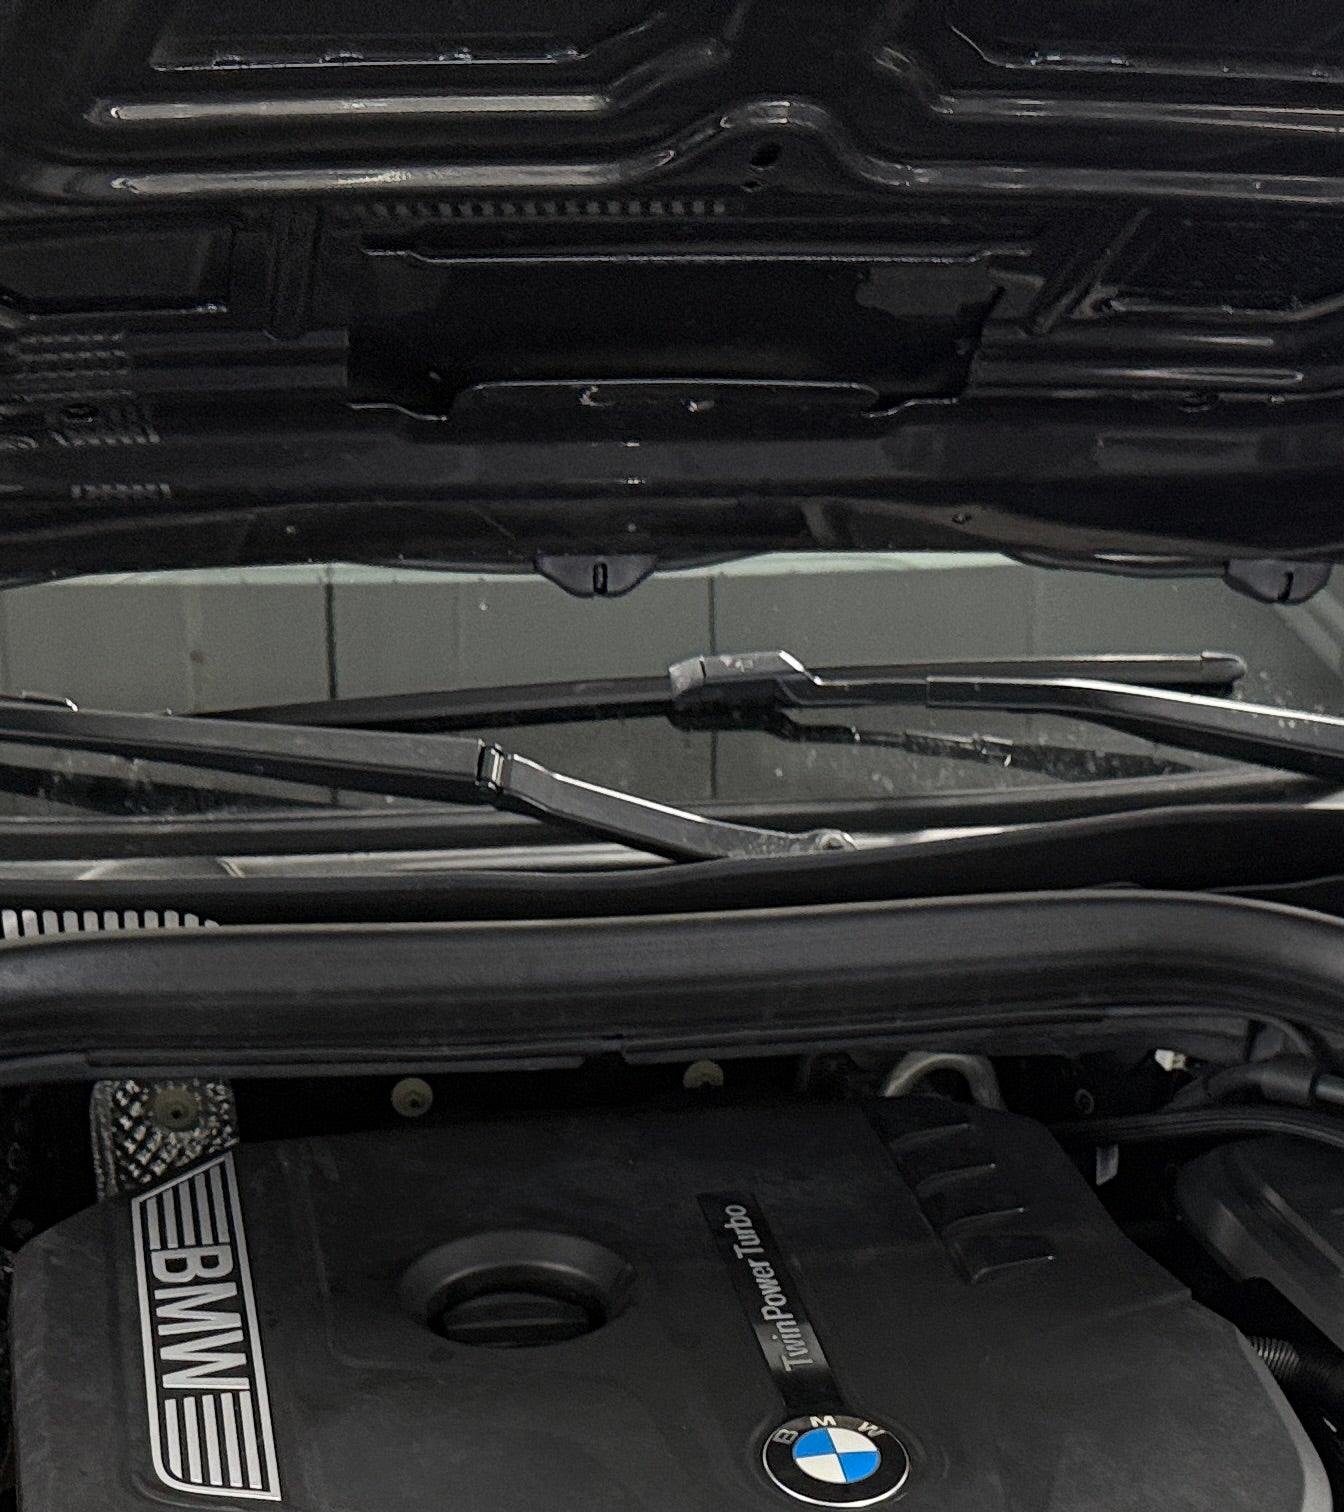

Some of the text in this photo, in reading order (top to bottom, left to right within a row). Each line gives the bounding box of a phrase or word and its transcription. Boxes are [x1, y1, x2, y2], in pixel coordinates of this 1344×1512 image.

[149, 1244, 251, 1391] BMW
[723, 1203, 813, 1373] TwinPower Turbo
[772, 1412, 886, 1446] BMW
